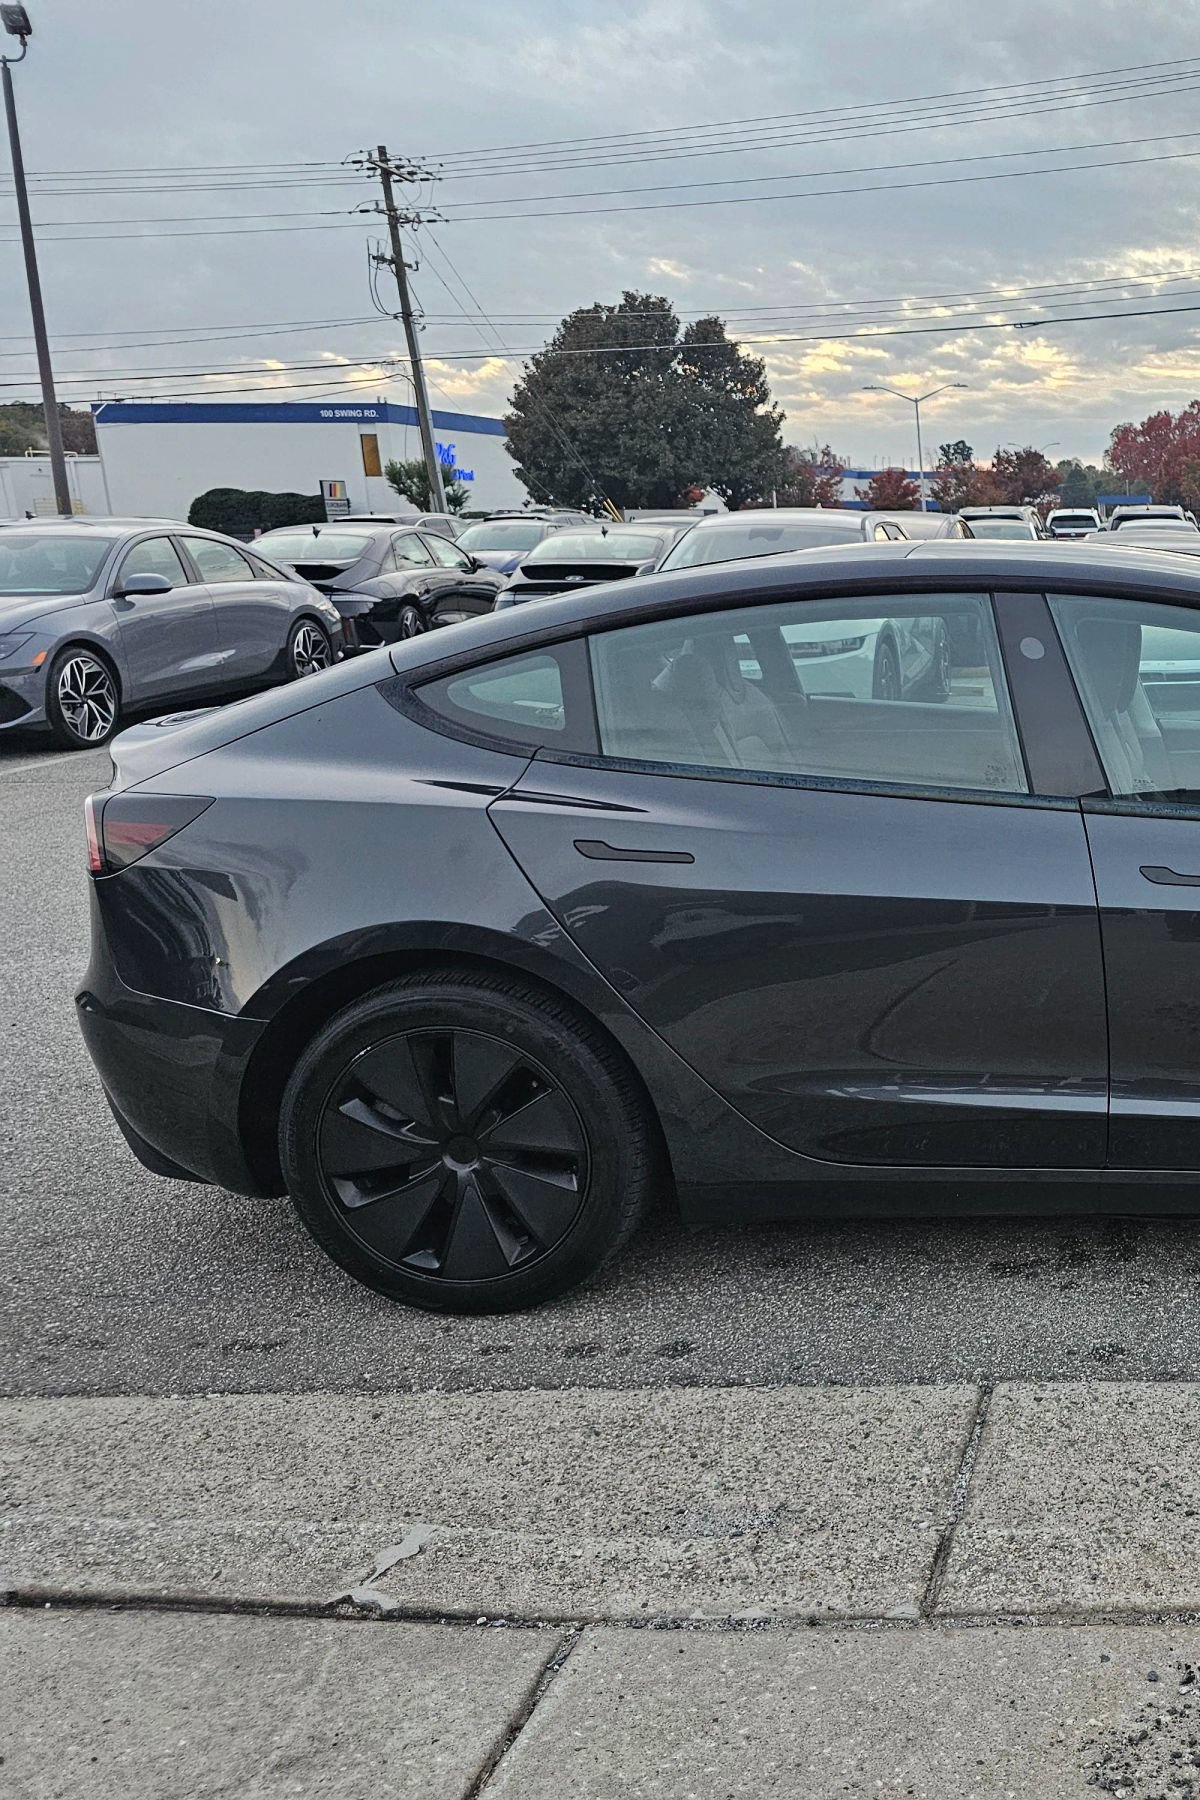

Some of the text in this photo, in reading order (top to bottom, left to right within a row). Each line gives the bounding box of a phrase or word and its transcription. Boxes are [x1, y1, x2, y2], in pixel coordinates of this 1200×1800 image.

[320, 409, 380, 418] 100 SWING RD.
